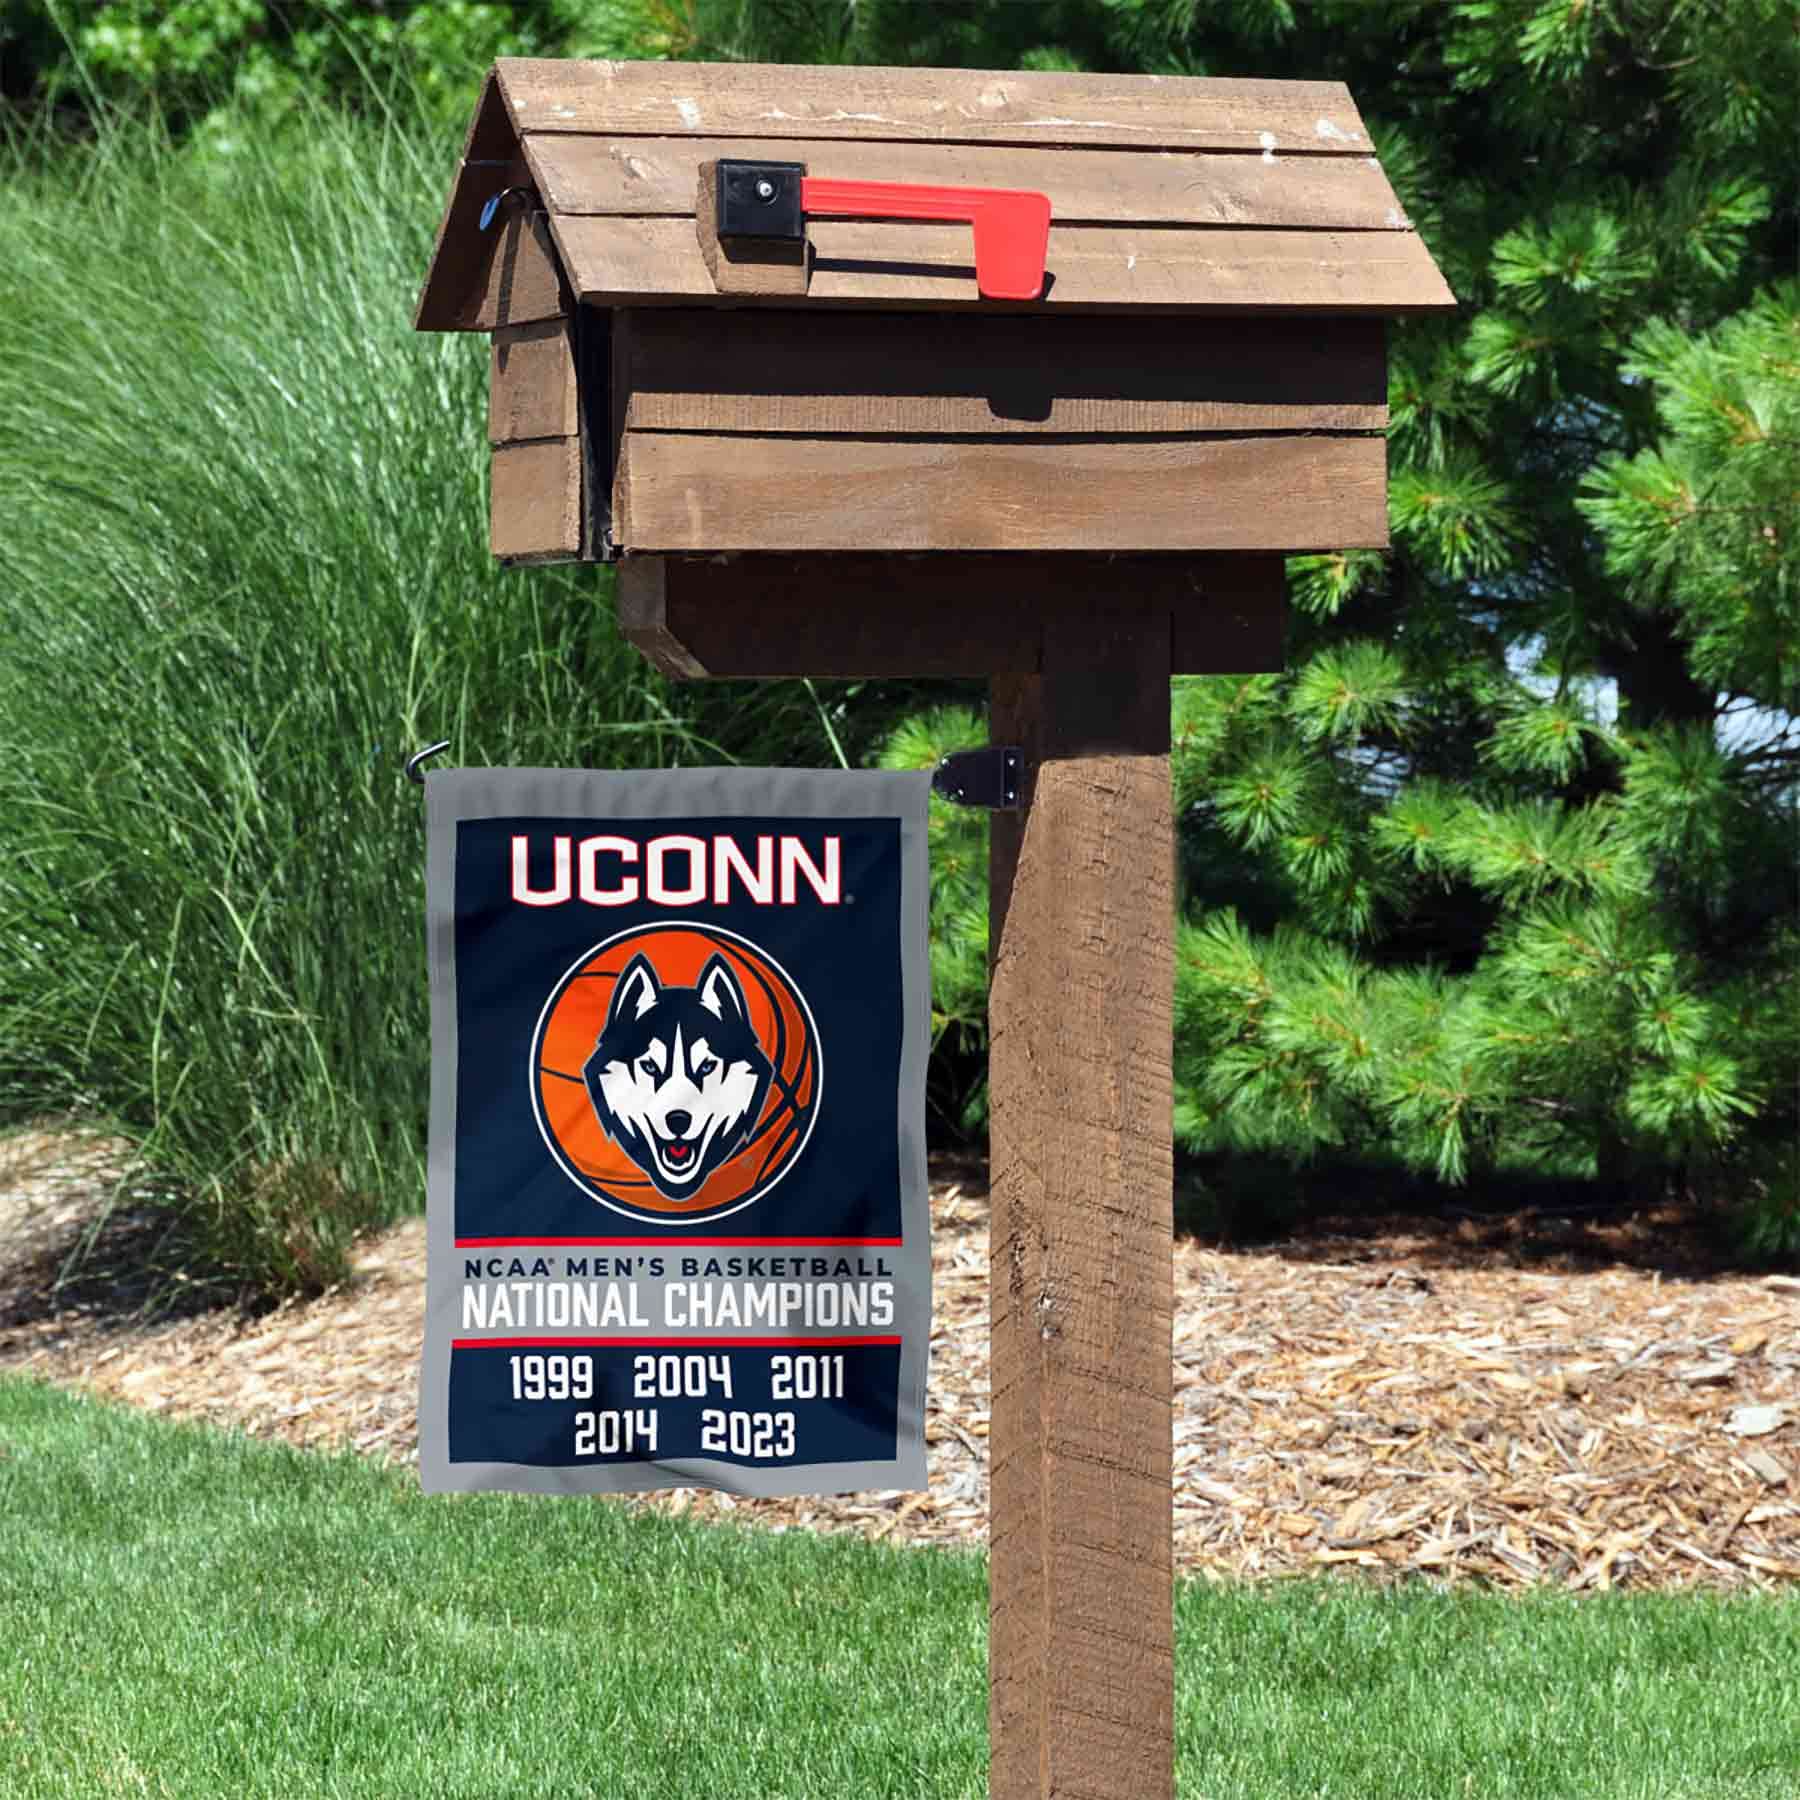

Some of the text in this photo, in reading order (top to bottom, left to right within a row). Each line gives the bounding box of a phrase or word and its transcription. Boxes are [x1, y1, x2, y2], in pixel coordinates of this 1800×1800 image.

[511, 835, 842, 907] UCONN
[681, 1256, 894, 1278] BASKETBALL
[462, 1281, 895, 1329] NATIONAL CHAMPIONS
[509, 1354, 845, 1400] 1999 2004 2011
[574, 1408, 796, 1458] 2014 2023
